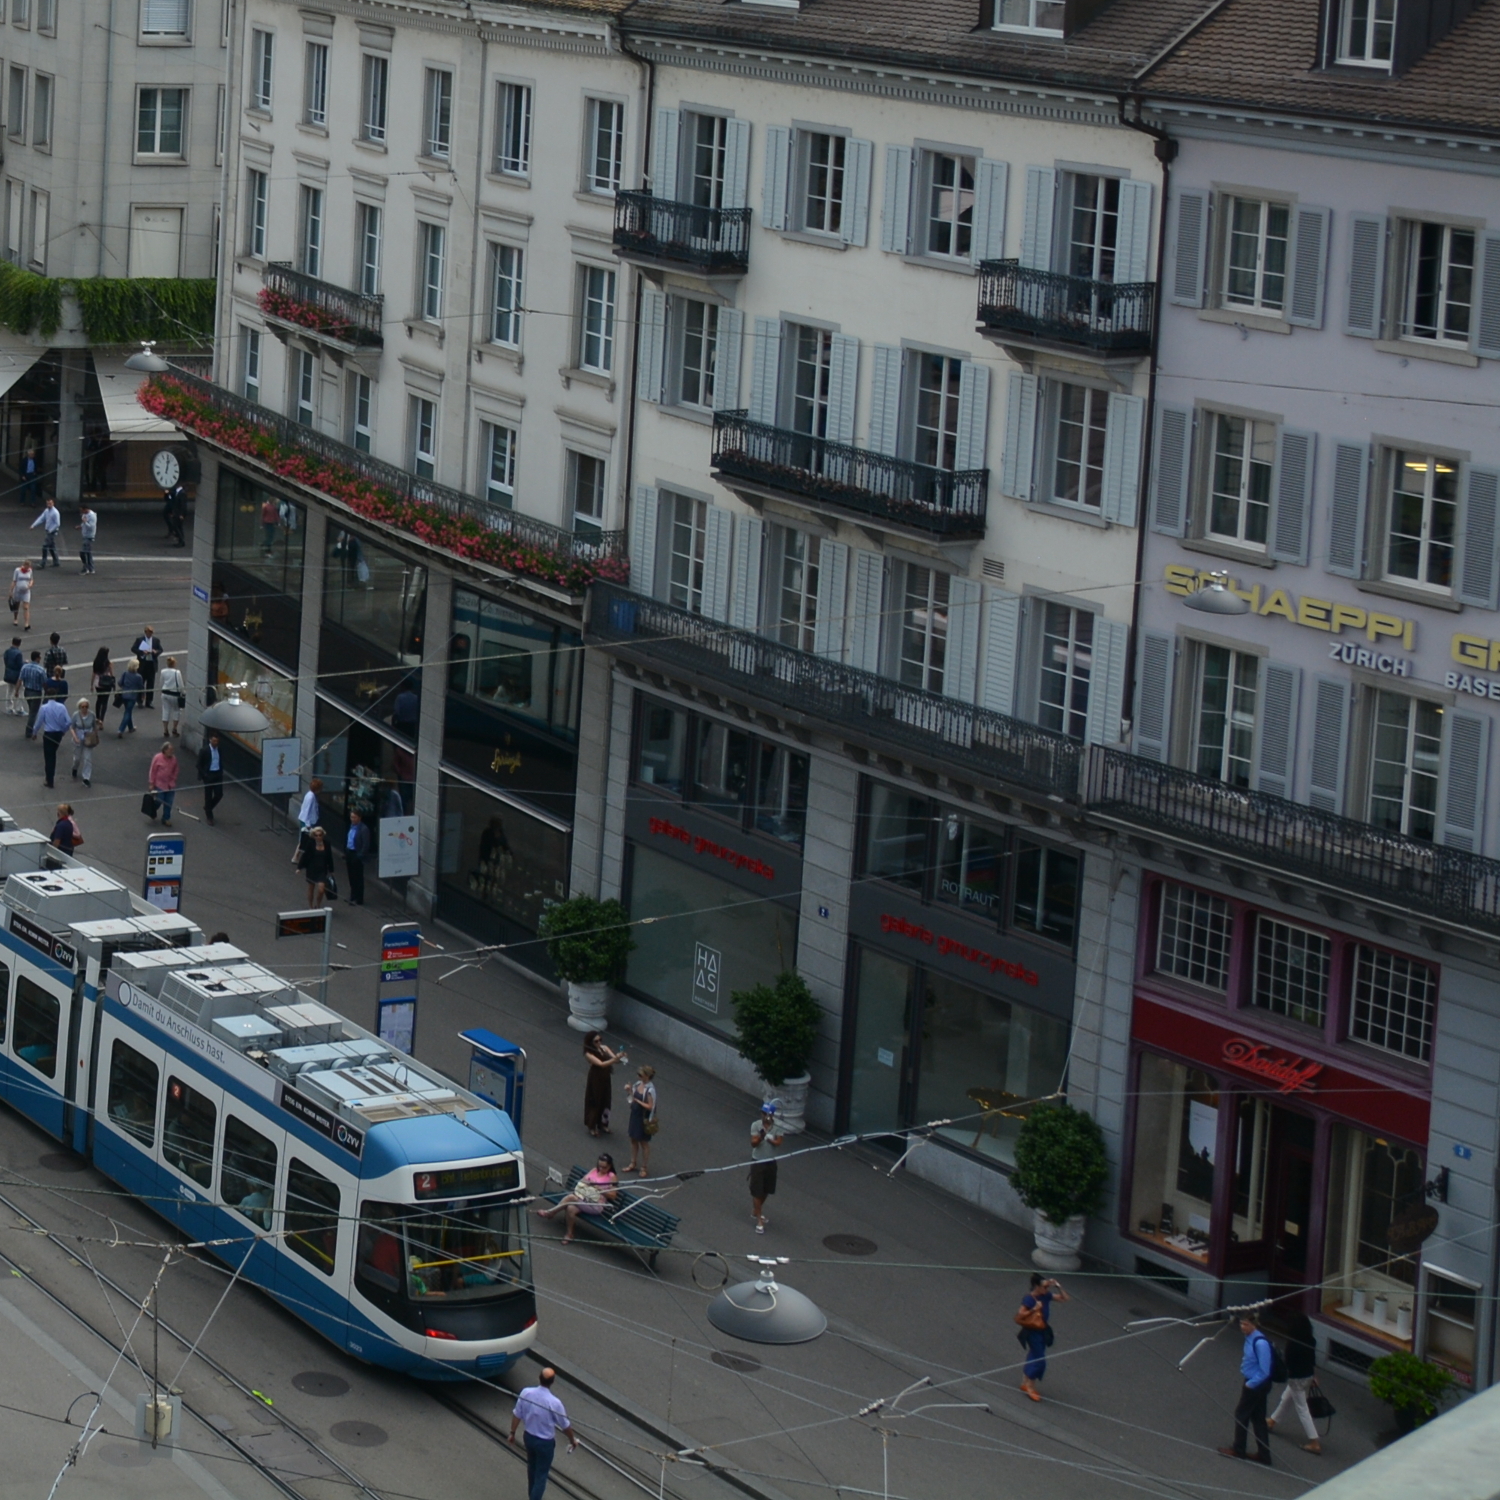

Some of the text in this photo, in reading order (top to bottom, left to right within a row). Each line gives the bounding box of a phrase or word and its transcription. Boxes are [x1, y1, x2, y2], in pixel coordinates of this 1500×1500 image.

[1329, 641, 1408, 677] ZÜRICH
[649, 816, 692, 845] galerie
[941, 878, 996, 908] ROTRAUT
[880, 912, 935, 946] galerie
[62, 949, 73, 963] ZVV
[132, 992, 226, 1064] Damit du Anschluss hast.
[1222, 1037, 1324, 1096] Davidoff
[346, 1133, 360, 1149] ZVV
[1457, 1146, 1465, 1157] 3
[421, 1173, 431, 1189] 2
